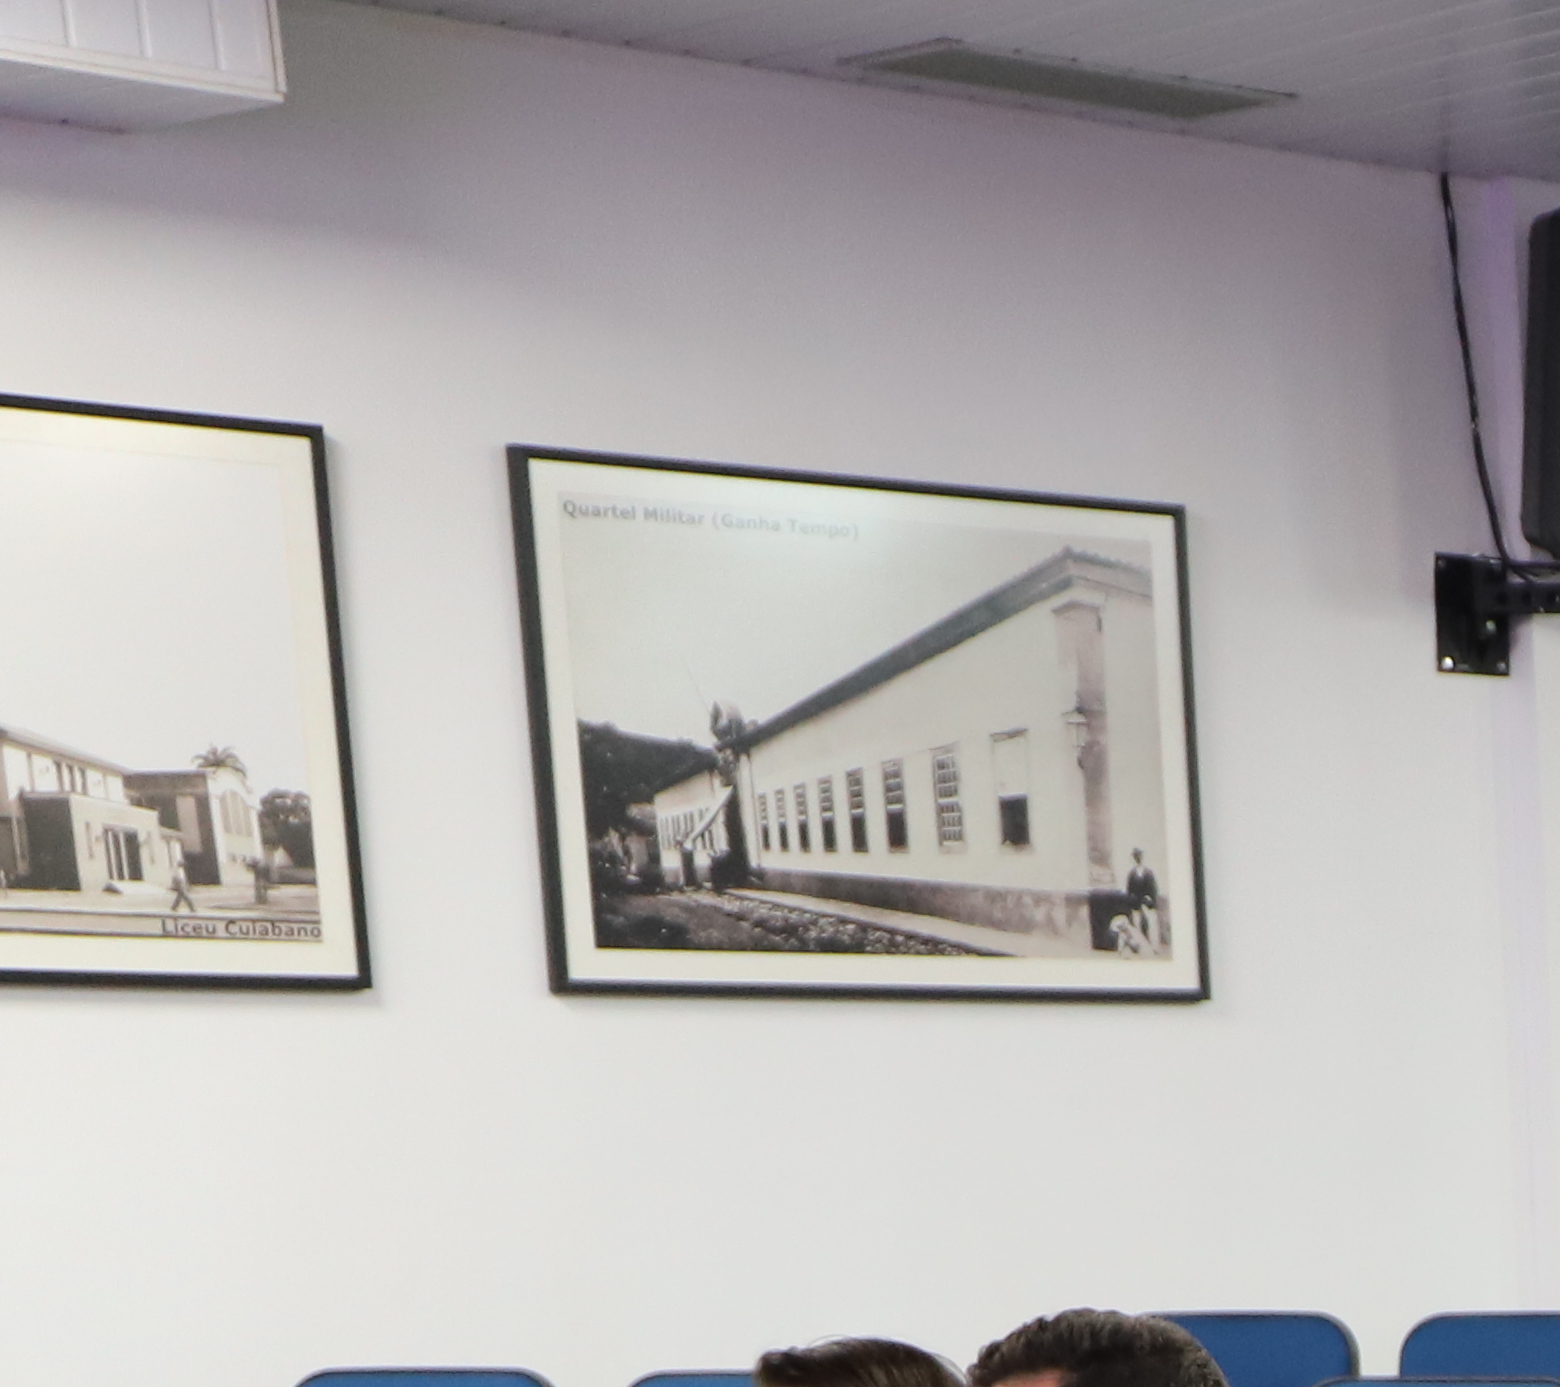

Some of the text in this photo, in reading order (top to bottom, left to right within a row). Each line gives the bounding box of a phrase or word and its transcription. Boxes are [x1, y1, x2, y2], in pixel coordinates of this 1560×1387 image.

[562, 499, 860, 541] Quartel Militar (Ganha Tempo)
[161, 918, 322, 938] Liceu Cuiabano
